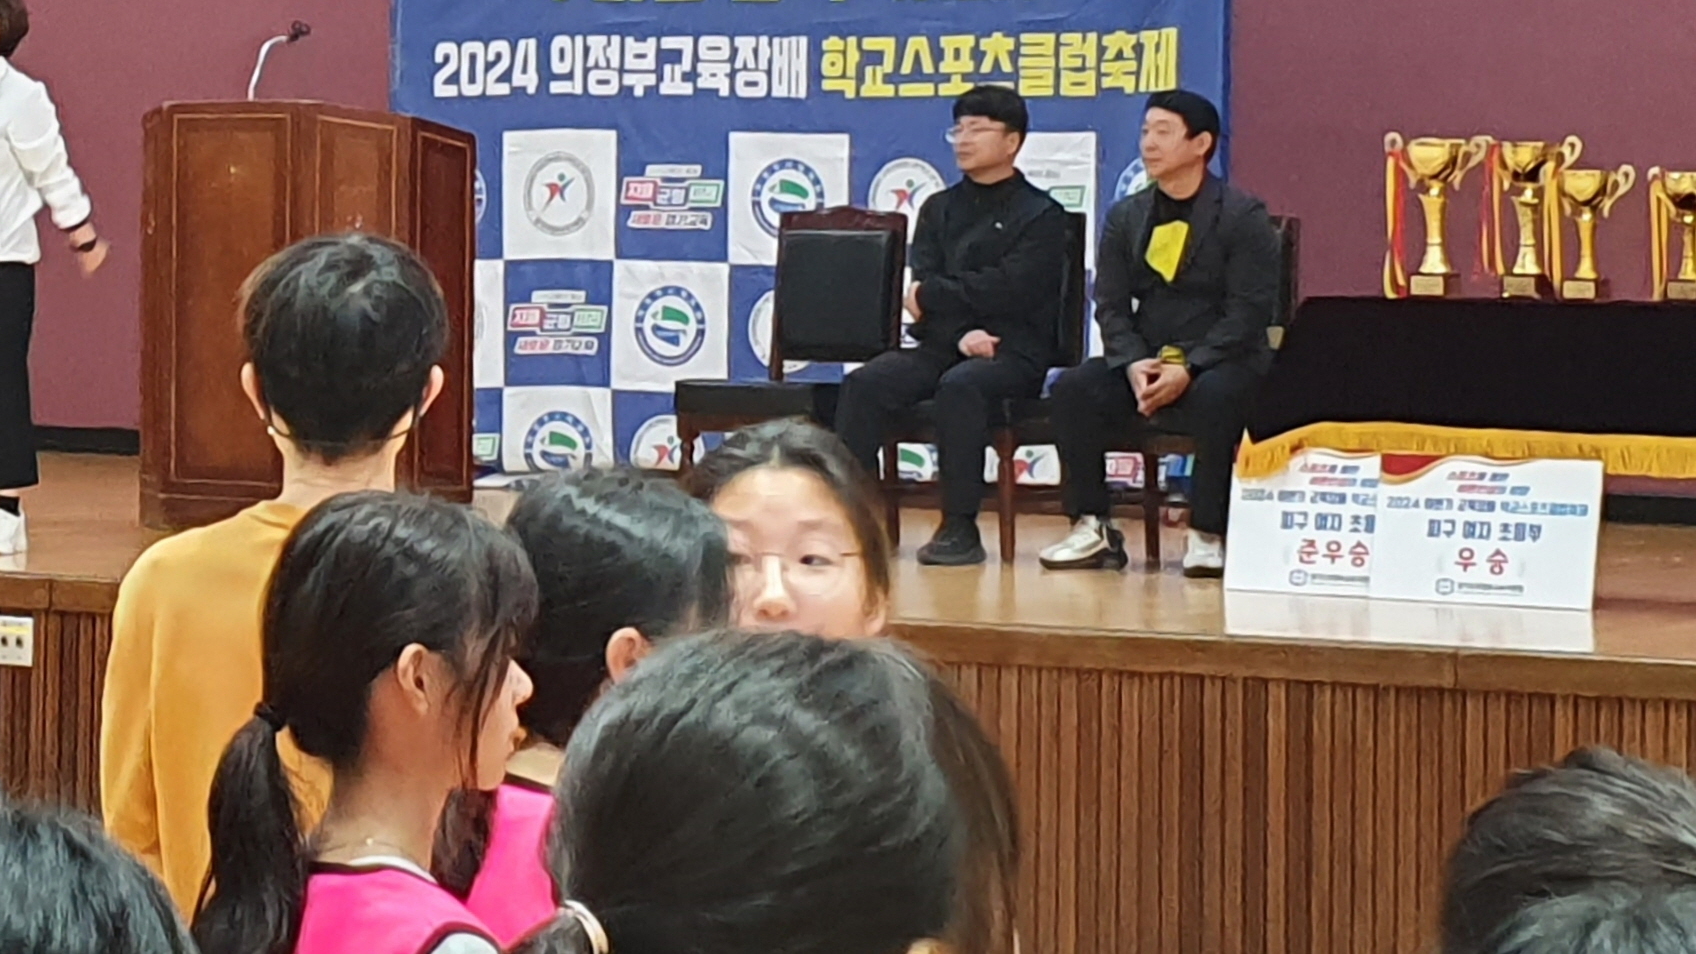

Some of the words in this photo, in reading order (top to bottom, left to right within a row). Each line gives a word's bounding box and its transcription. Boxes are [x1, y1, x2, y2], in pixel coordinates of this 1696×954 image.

[433, 37, 539, 98] 2024
[549, 34, 807, 98] 의정부교육장배
[821, 27, 1178, 98] 학교스포츠클럽축제
[1297, 538, 1370, 568] 준우승
